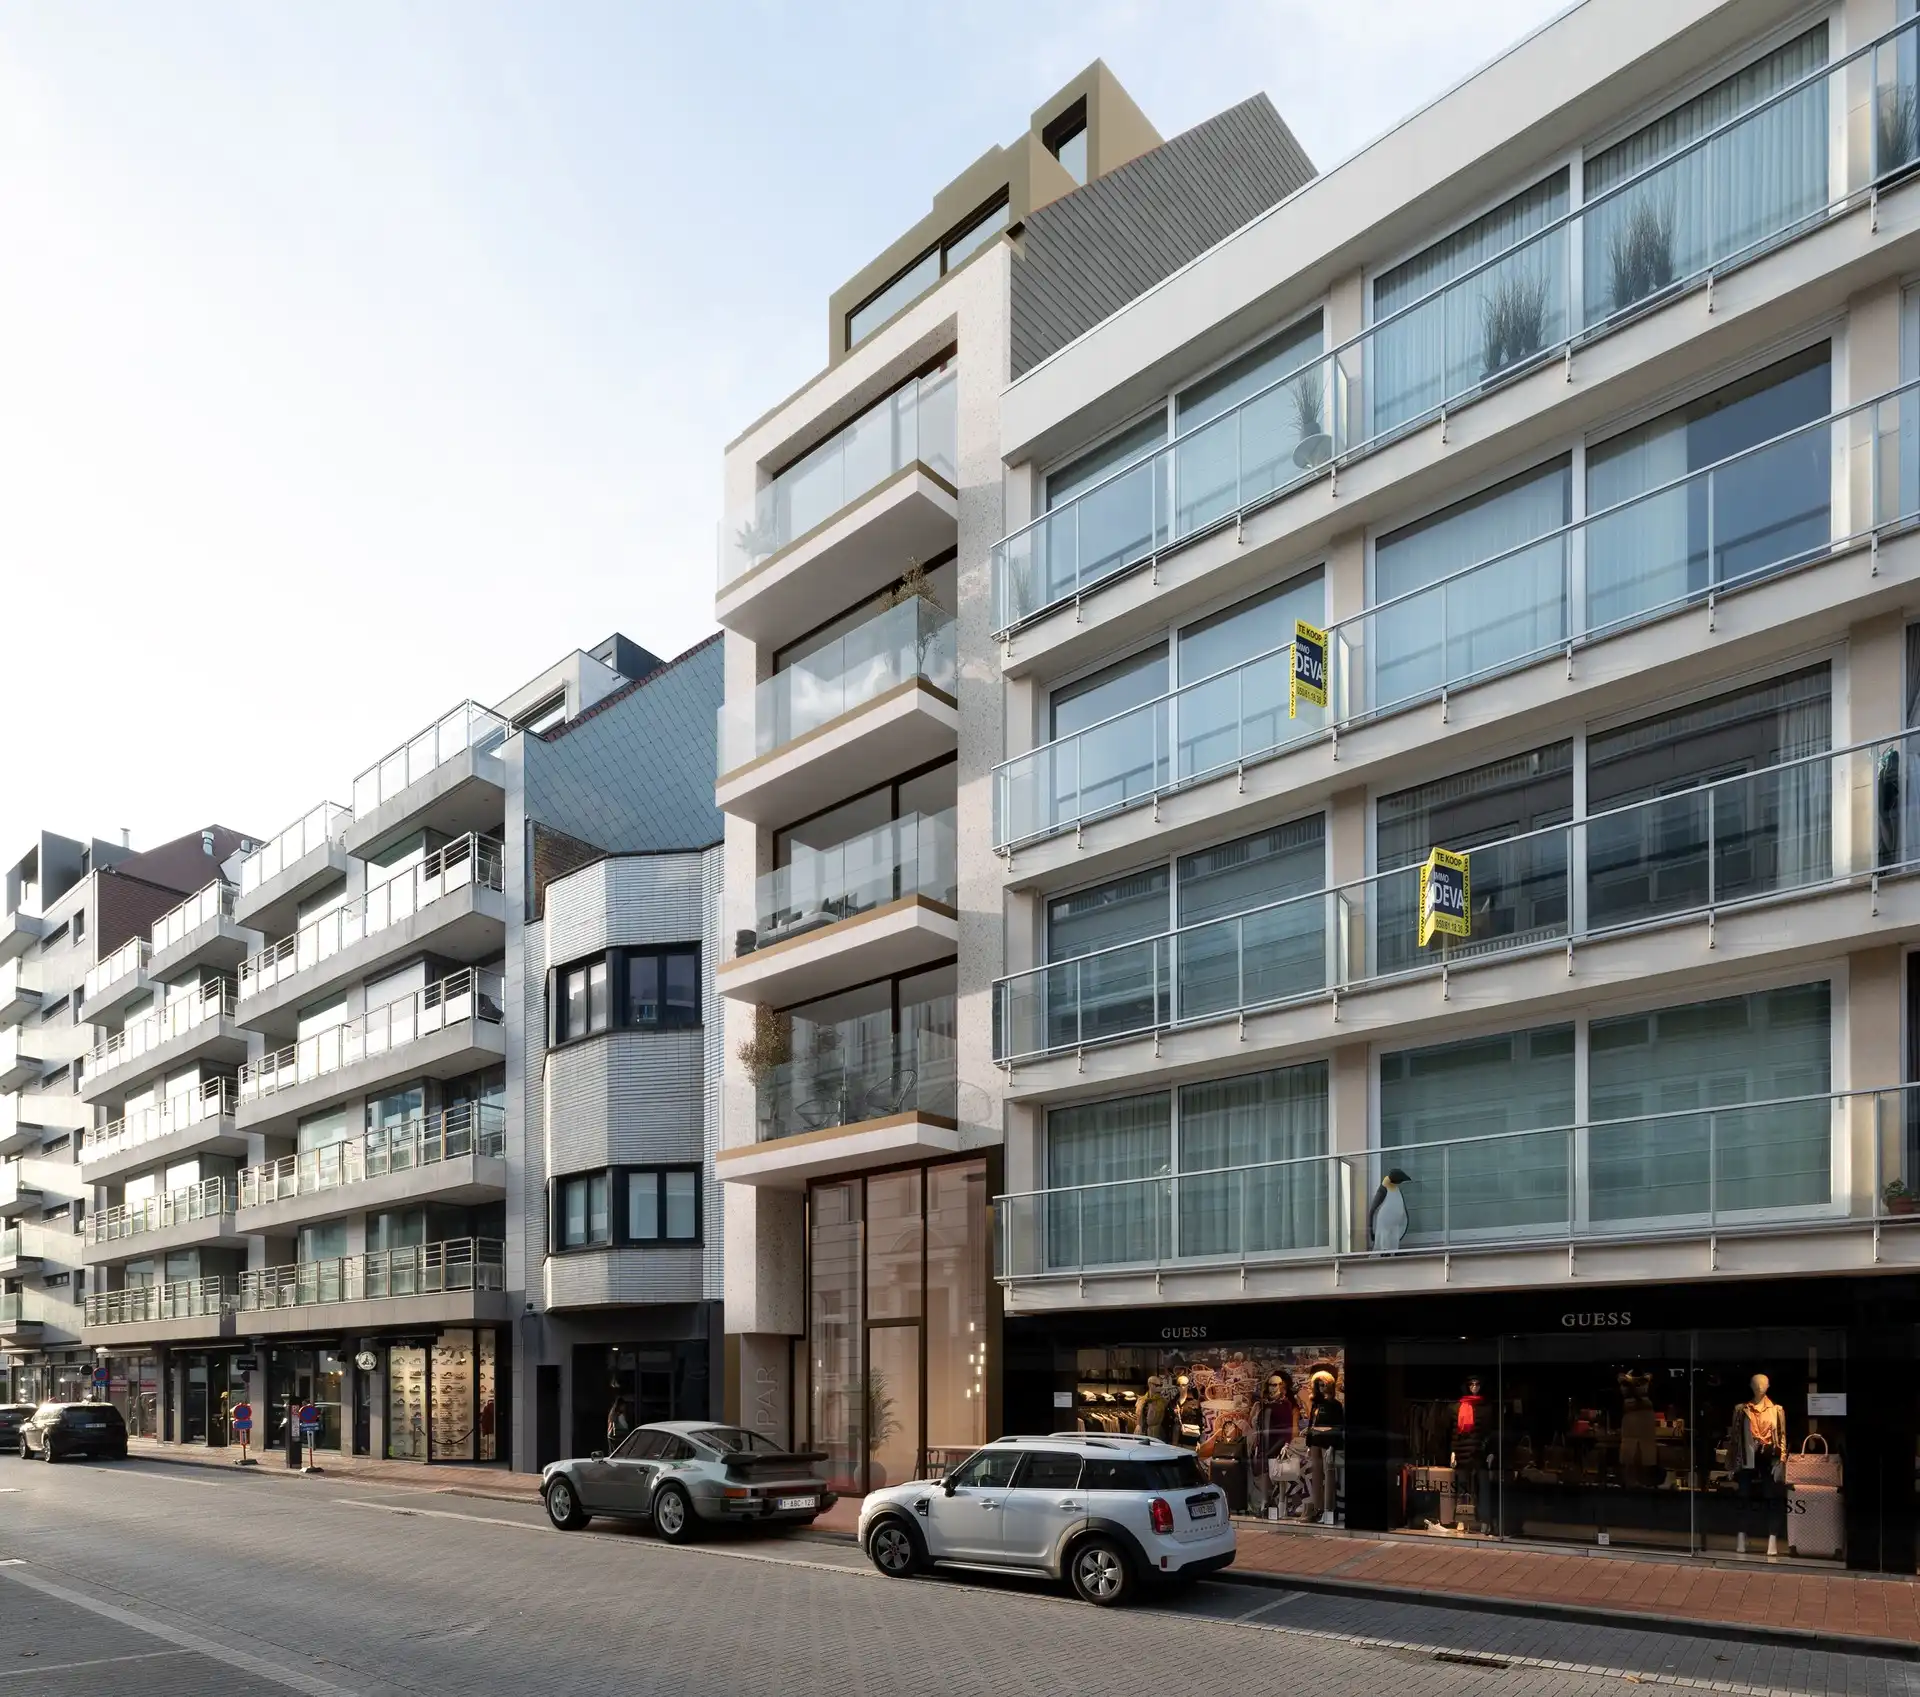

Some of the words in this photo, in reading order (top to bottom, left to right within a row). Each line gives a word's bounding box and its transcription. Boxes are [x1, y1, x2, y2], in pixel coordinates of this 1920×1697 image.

[1298, 623, 1306, 635] TE
[1306, 627, 1322, 642] KOOP
[1296, 651, 1323, 681] DEVA
[1436, 852, 1445, 862] TE
[1446, 855, 1462, 868] KOOP
[1434, 871, 1450, 883] IMMO
[1432, 882, 1464, 909] DEVA
[1561, 1312, 1632, 1327] GUESS
[1161, 1326, 1207, 1339] GUESS
